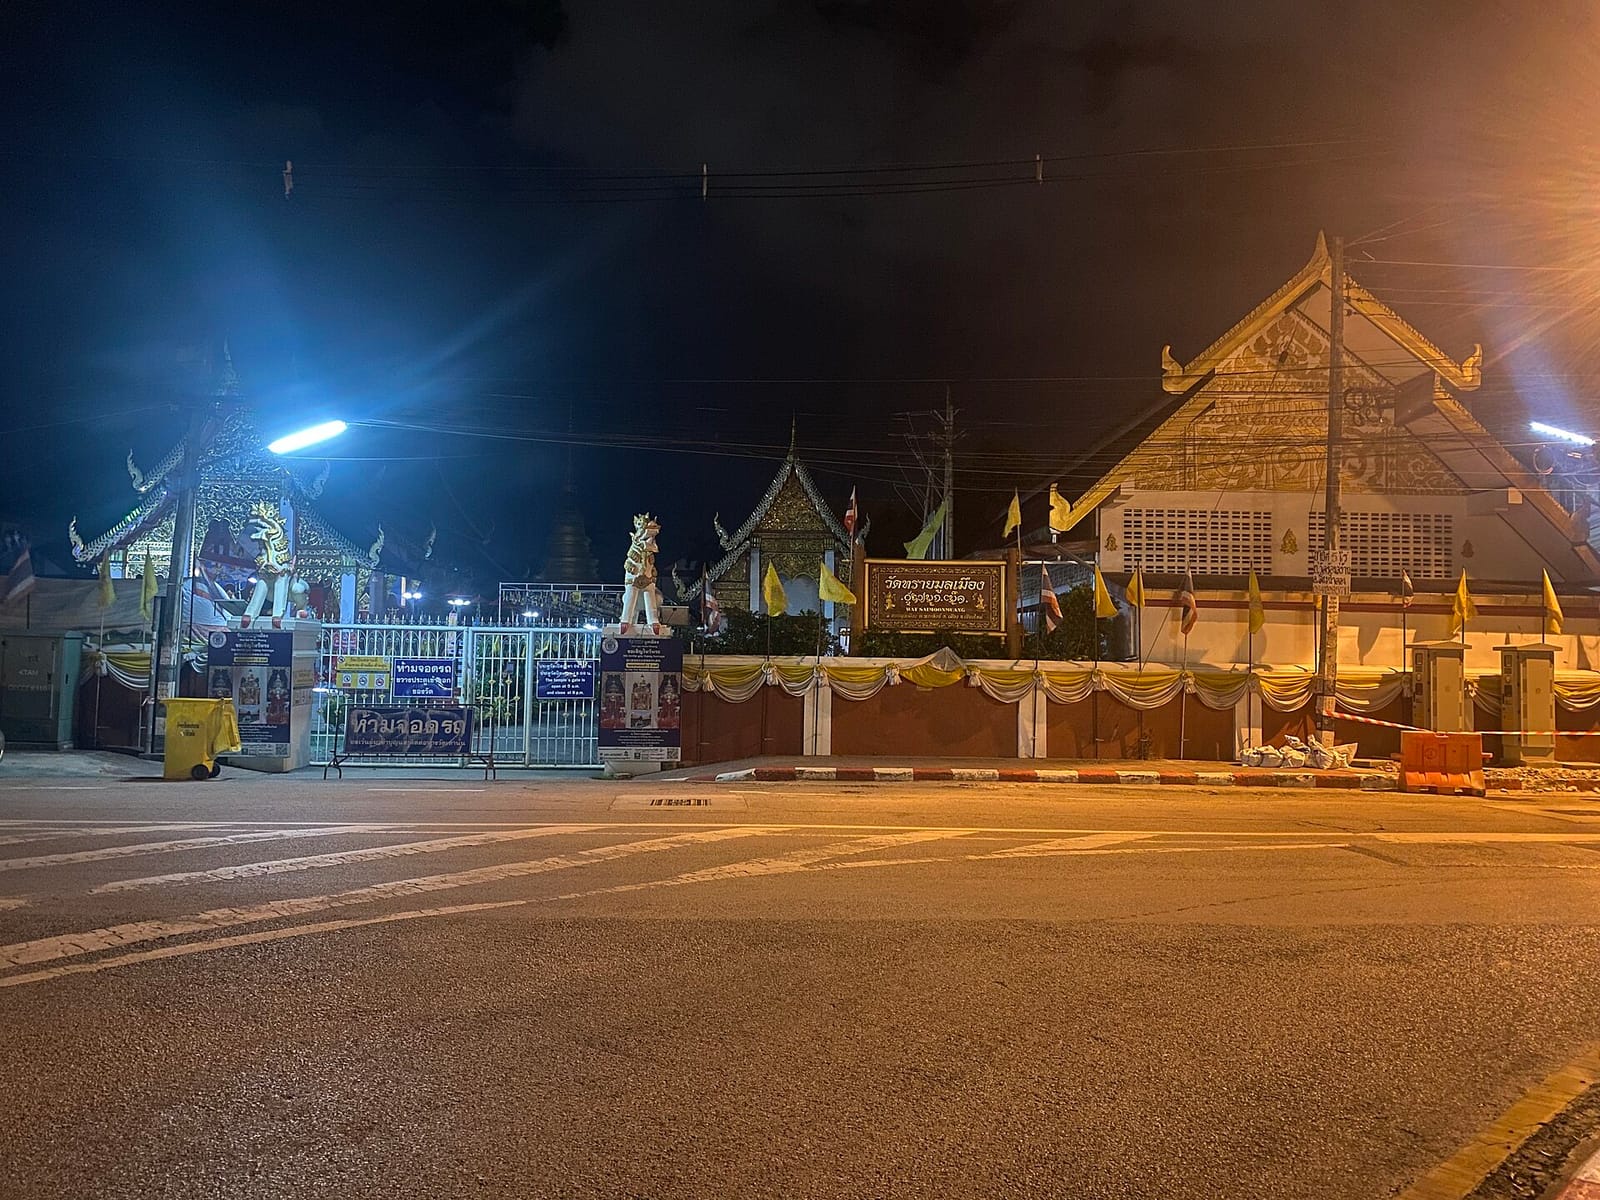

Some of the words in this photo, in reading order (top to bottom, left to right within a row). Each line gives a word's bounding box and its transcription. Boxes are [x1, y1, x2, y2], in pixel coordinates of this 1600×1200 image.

[885, 576, 985, 593] วัดทรายมูลเมือง
[396, 661, 452, 674] ห้ามจอดรถ
[412, 687, 434, 695] ของวัด
[353, 711, 466, 734] ห้ามจอดรถ
